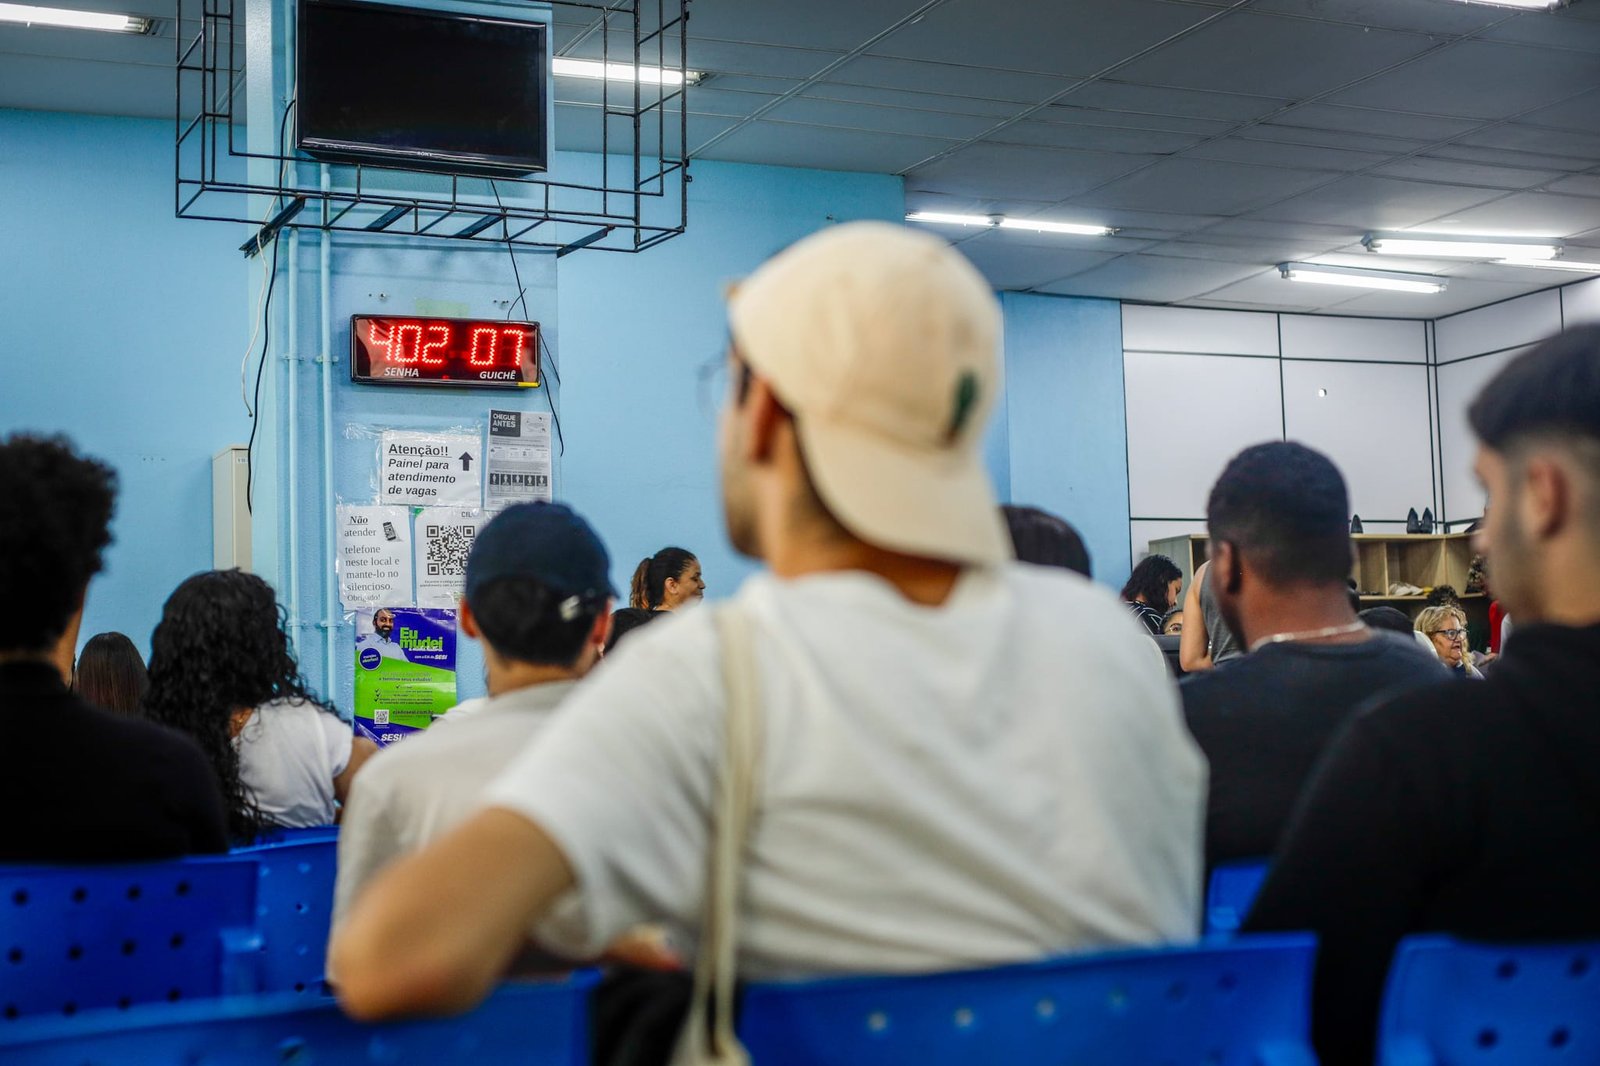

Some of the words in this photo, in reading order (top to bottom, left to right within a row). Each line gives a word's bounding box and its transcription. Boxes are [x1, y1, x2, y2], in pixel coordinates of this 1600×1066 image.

[369, 324, 449, 364] 402
[470, 328, 524, 366] 07
[384, 367, 420, 378] SENHA
[479, 370, 516, 380] GUICHÊ
[492, 413, 516, 421] CHEGUE
[492, 420, 516, 428] ANTES
[388, 443, 449, 457] Atenção!!
[388, 458, 423, 469] Painel
[425, 461, 449, 471] para
[388, 472, 456, 484] atendimento
[388, 485, 402, 495] de
[405, 487, 437, 498] vagas
[350, 515, 369, 524] Não
[344, 527, 376, 537] atender
[345, 545, 381, 554] telefone
[345, 559, 368, 567] neste
[371, 556, 392, 566] local
[346, 569, 386, 579] mante-lo
[387, 570, 399, 578] no
[346, 582, 393, 591] silencioso.
[400, 627, 418, 640] Eu
[400, 637, 443, 649] mudei
[381, 733, 402, 742] SESI
